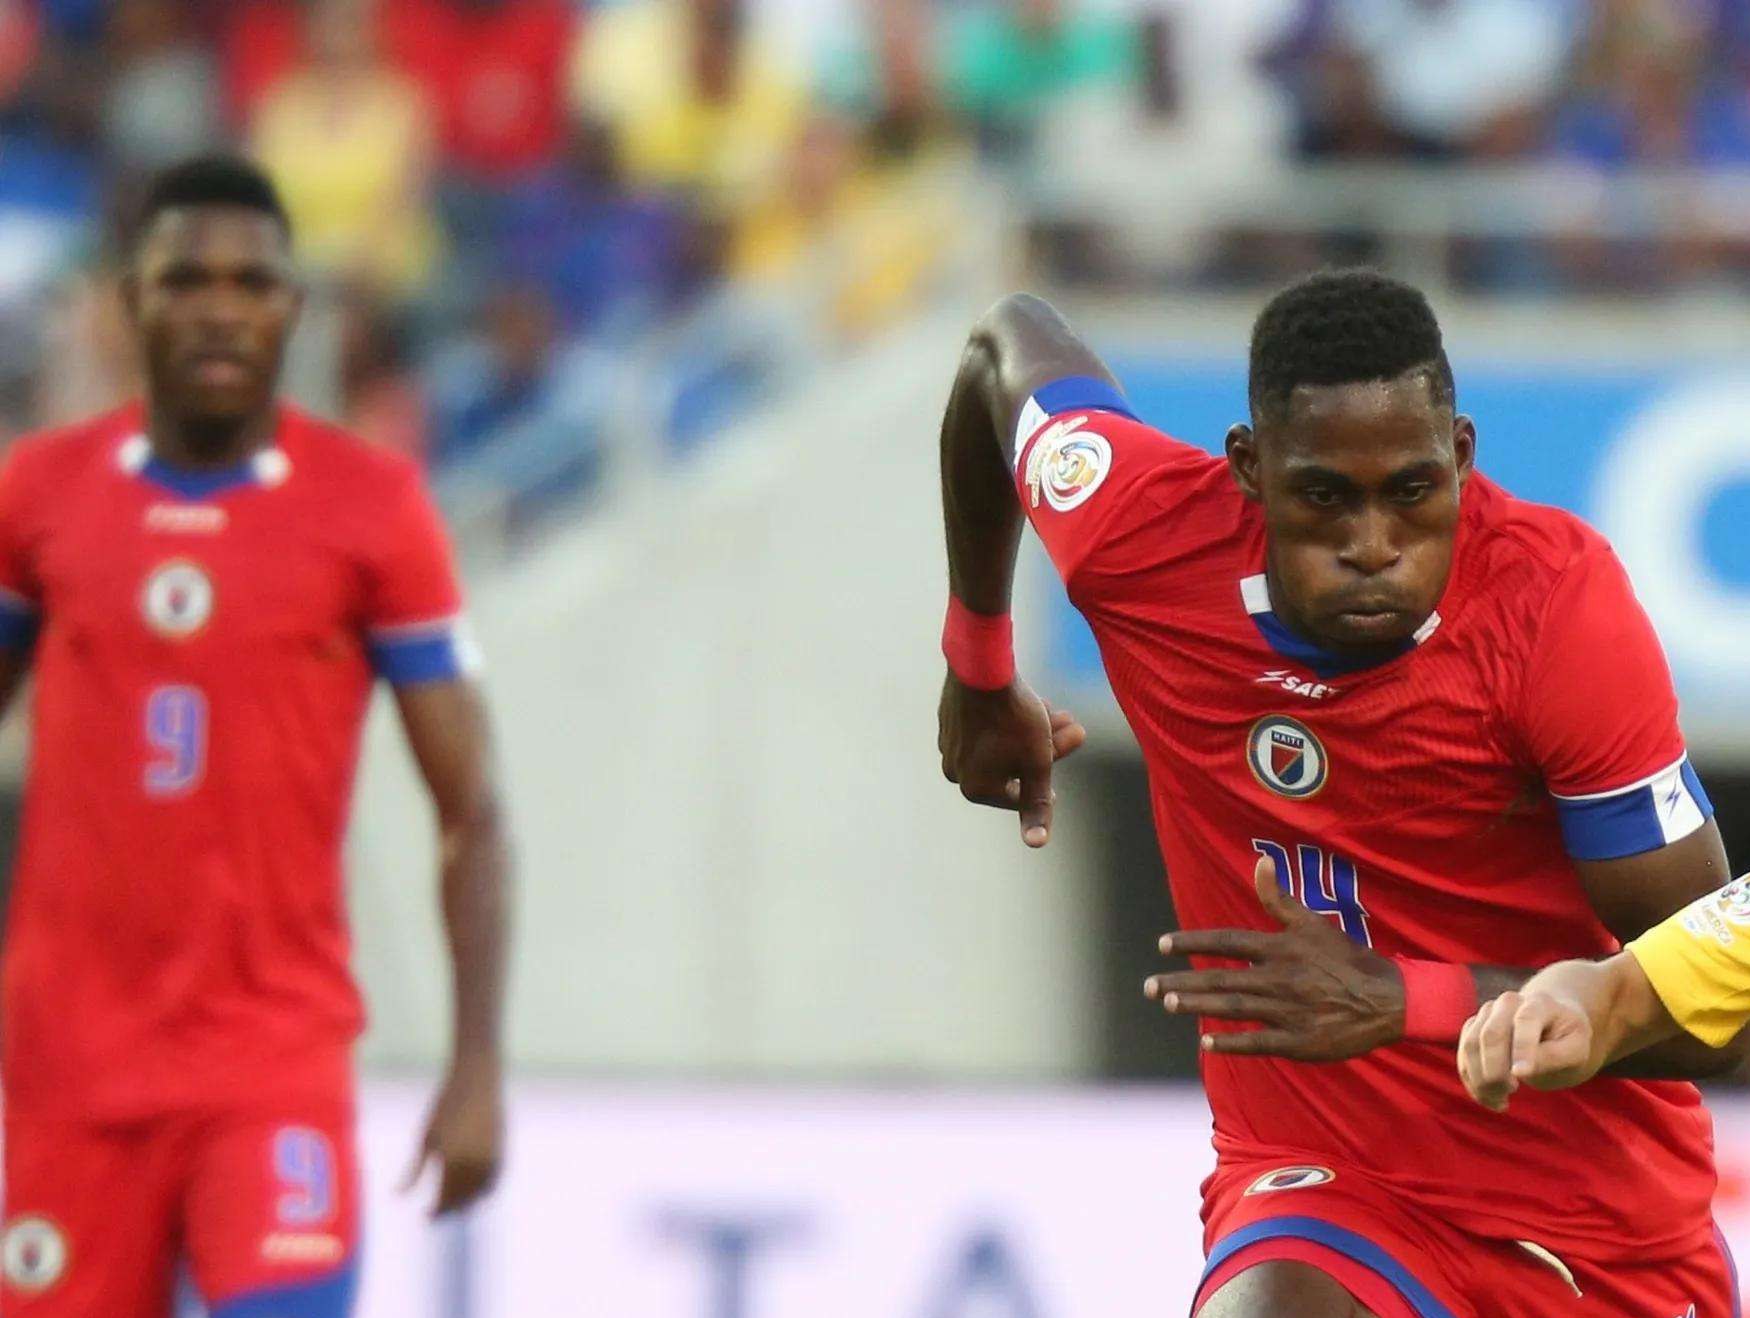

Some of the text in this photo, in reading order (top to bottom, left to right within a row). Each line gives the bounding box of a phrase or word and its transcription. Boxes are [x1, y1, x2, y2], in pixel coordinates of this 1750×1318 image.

[145, 685, 208, 796] 9
[1273, 732, 1302, 747] HAITI
[275, 1125, 337, 1224] 9
